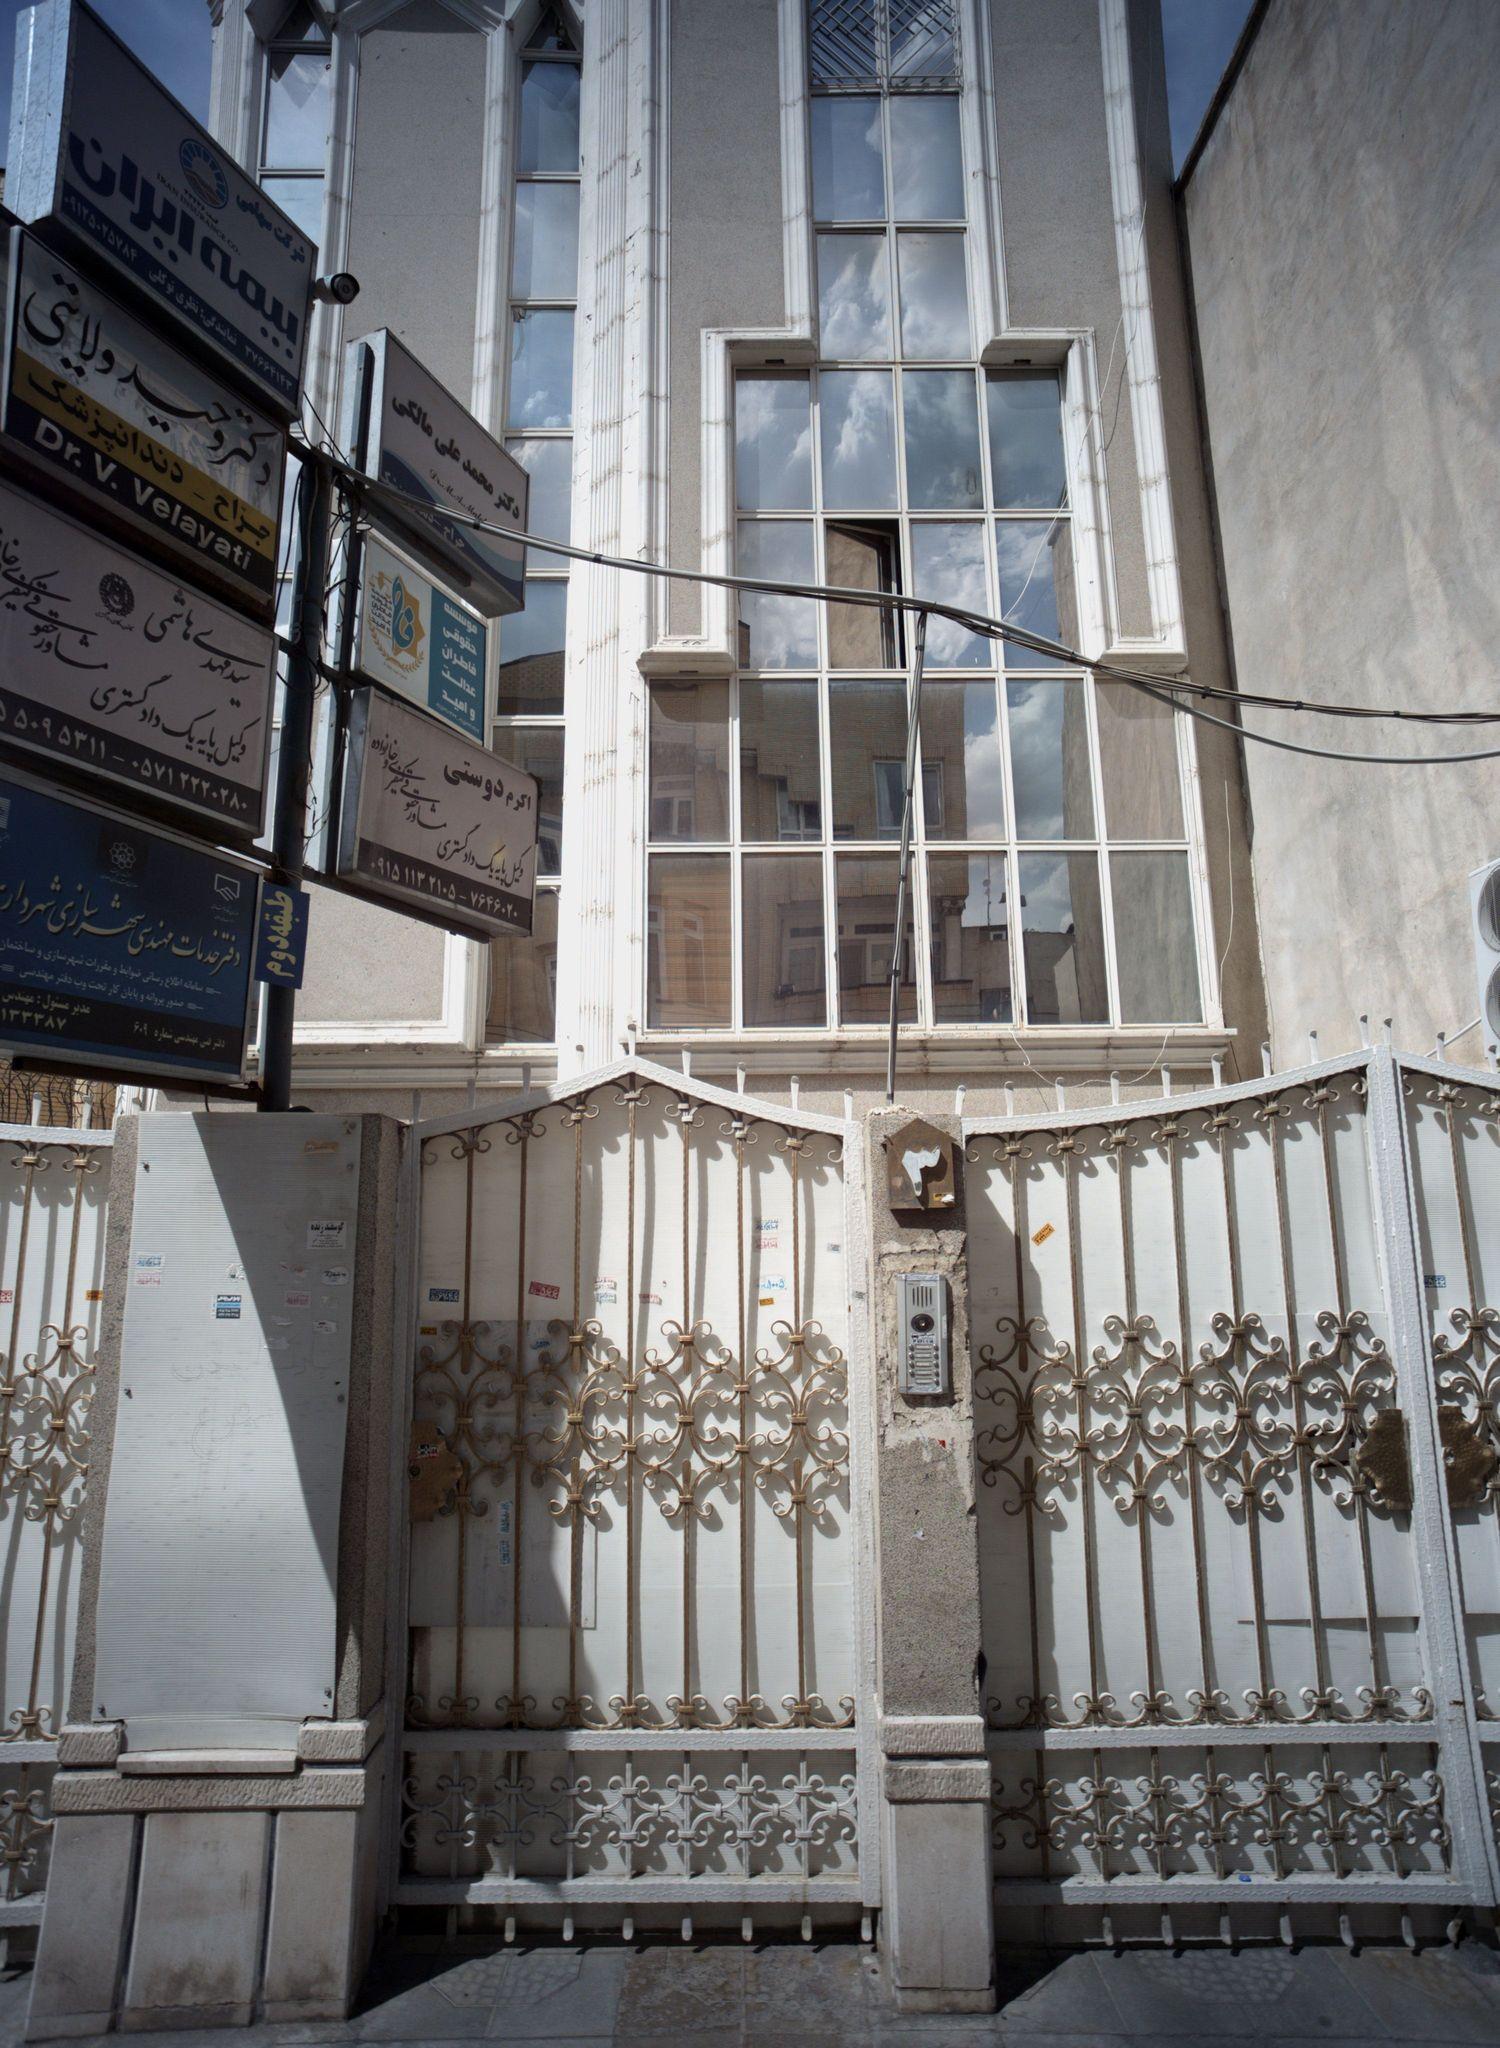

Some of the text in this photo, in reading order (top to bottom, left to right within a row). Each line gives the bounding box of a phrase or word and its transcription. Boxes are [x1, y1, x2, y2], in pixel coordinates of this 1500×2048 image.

[69, 131, 298, 359] بیمه ایران
[34, 419, 252, 571] Dr. V. Velayati
[442, 627, 477, 656] حقوقی
[441, 664, 476, 697] عدالت
[443, 761, 531, 811] اکرم دوستی
[370, 857, 400, 880] ۰۹۱۵
[404, 866, 426, 888] ۱۱۳
[264, 890, 301, 937] طبقه
[266, 935, 296, 978] دوم
